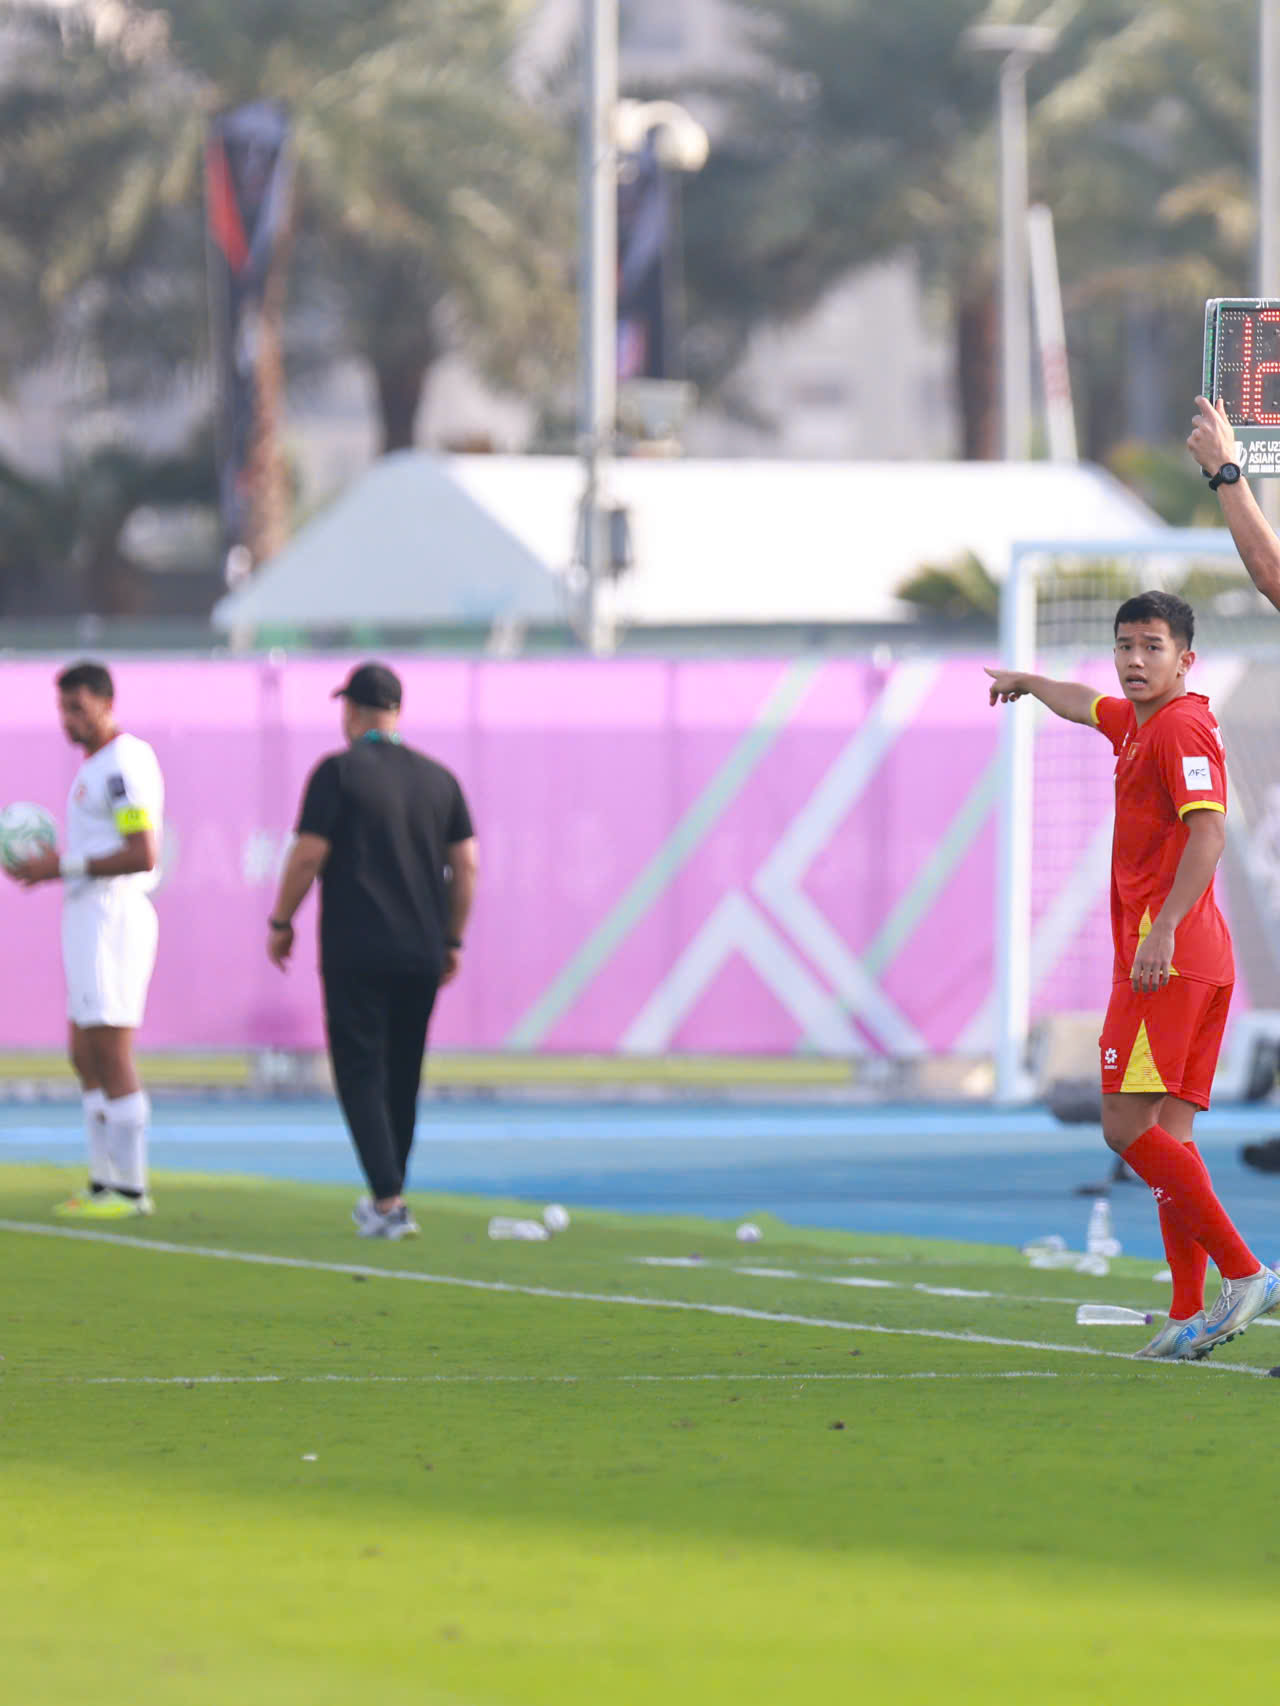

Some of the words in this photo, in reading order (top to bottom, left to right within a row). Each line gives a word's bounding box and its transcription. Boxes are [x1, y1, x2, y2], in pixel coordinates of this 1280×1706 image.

[1249, 440, 1267, 453] AFC
[1248, 452, 1275, 464] ASIAN
[1188, 768, 1207, 776] AFC
